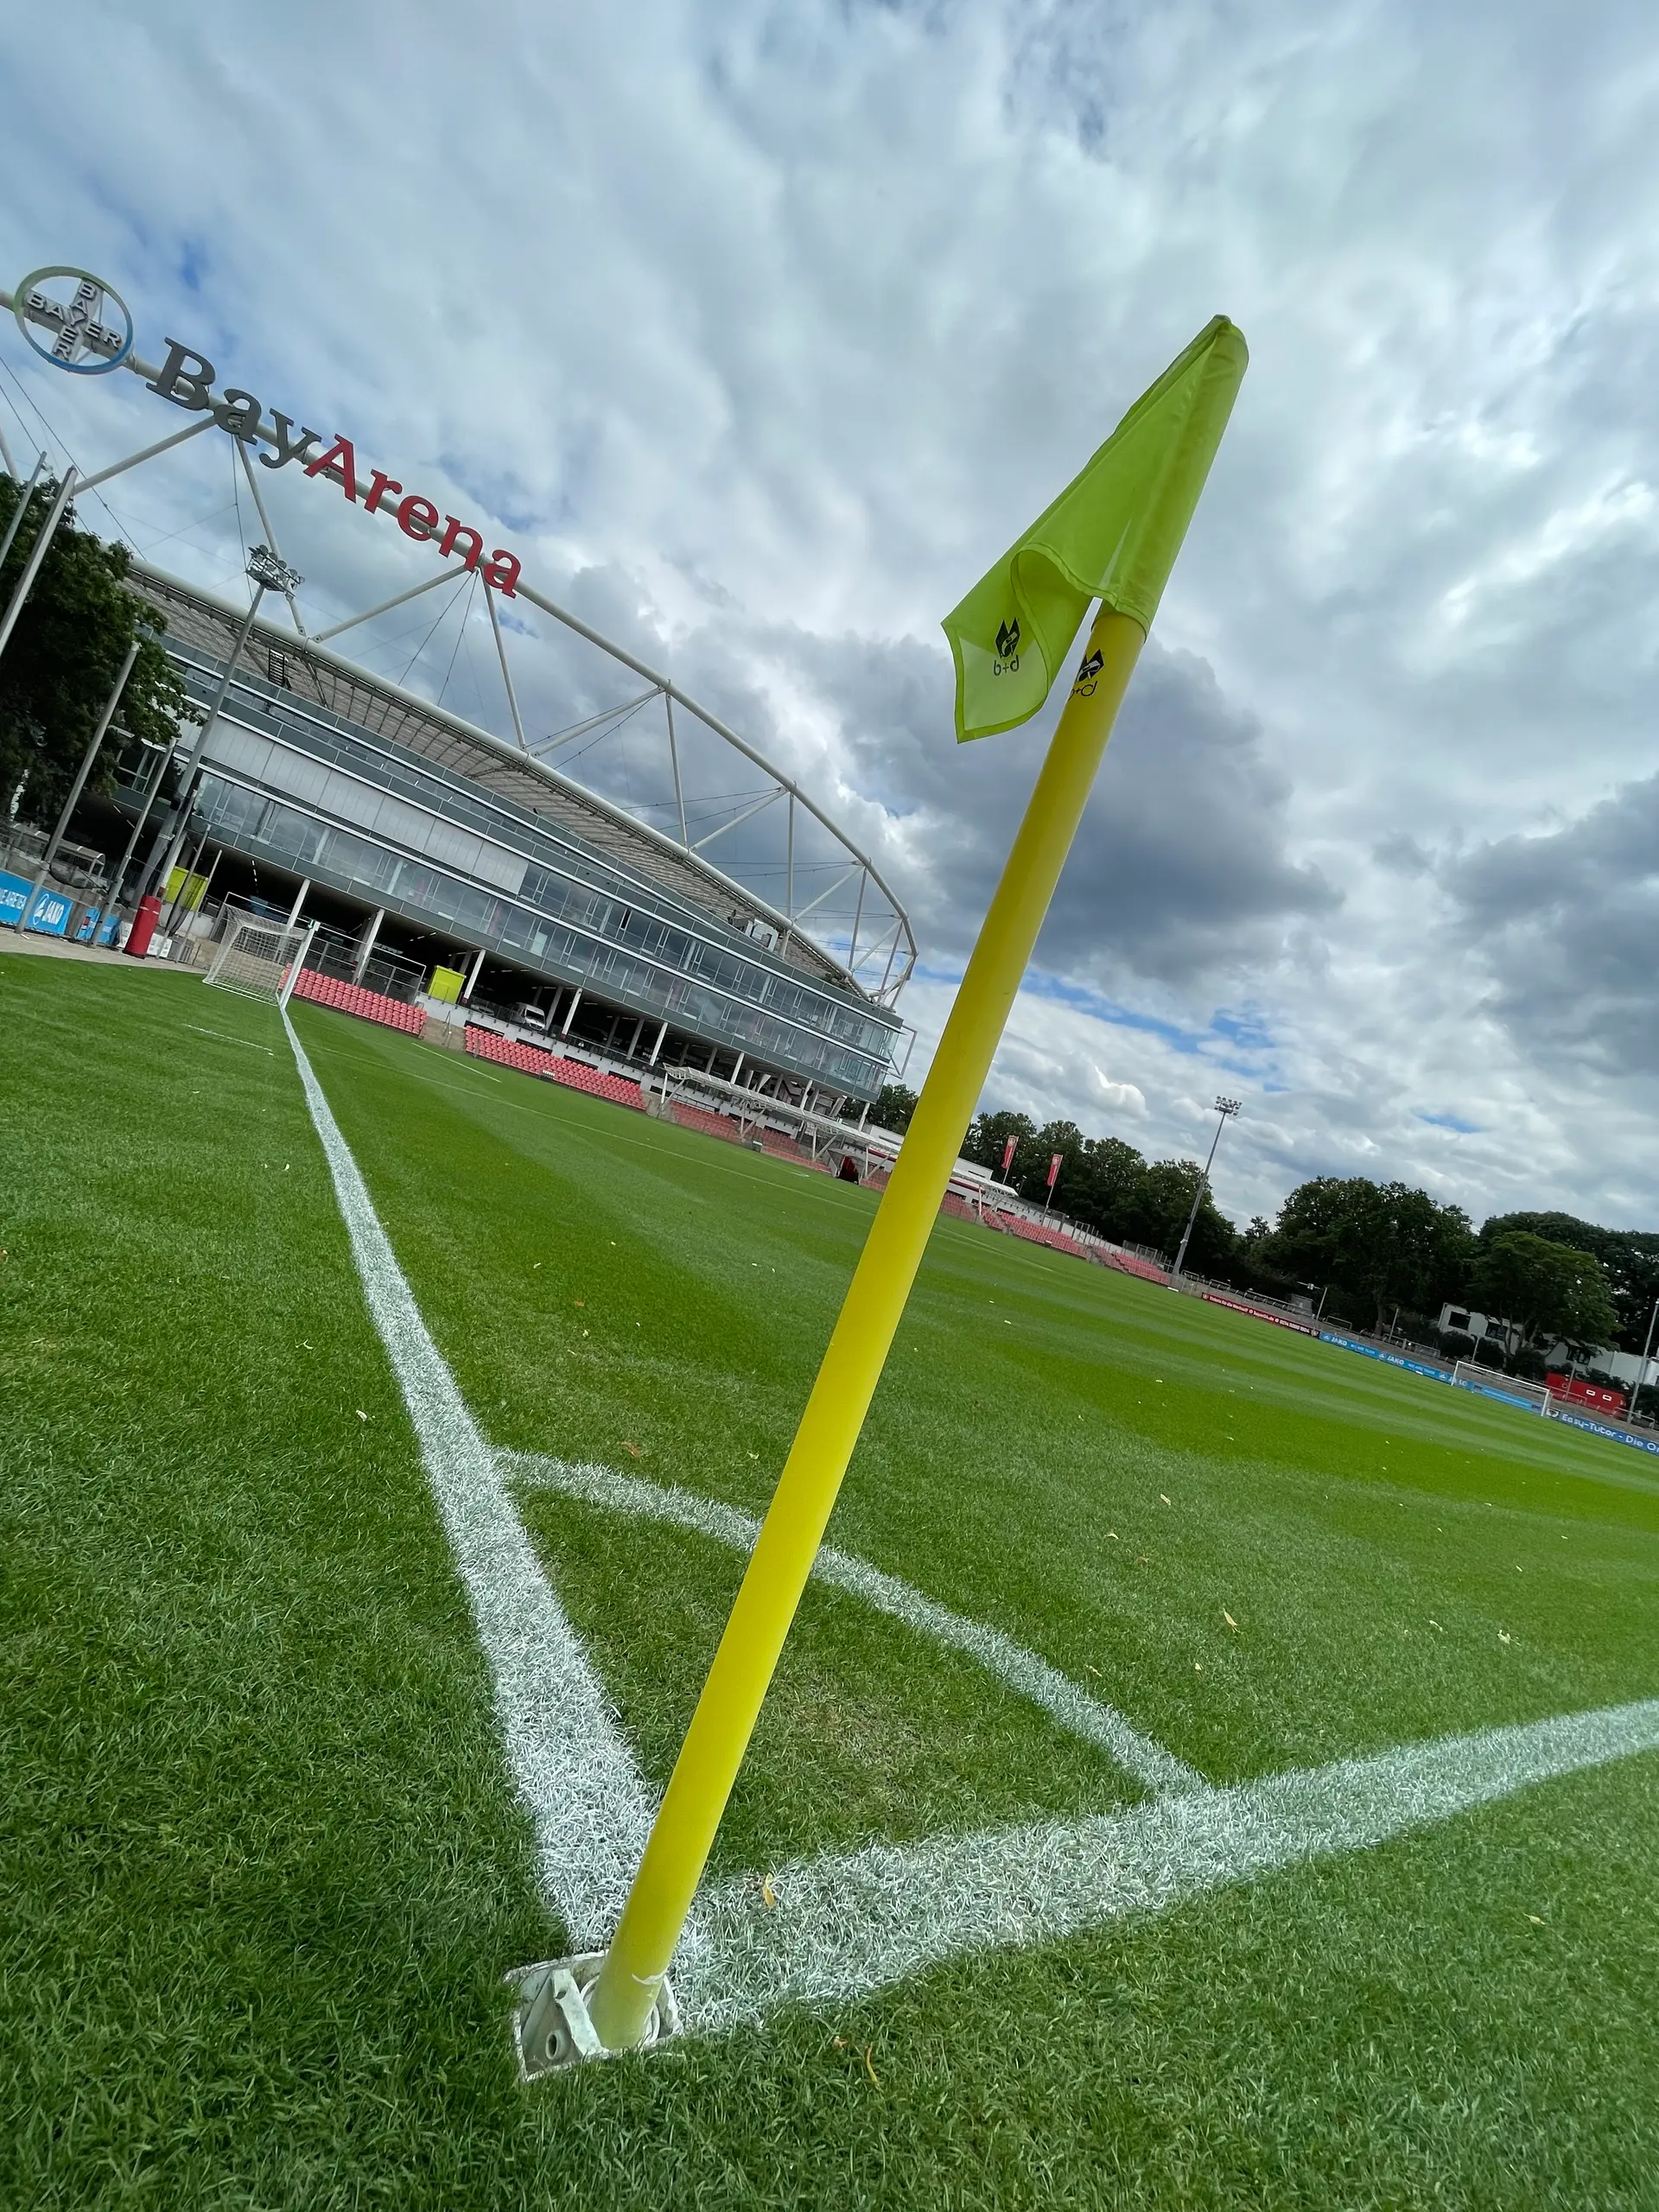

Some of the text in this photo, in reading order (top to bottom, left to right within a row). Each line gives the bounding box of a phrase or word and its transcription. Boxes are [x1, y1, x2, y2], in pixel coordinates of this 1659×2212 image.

[27, 294, 123, 349] BAYER
[53, 283, 97, 362] BAYER
[145, 336, 522, 599] BayArena
[993, 654, 1020, 677] b+d
[41, 900, 65, 925] JAKO
[1331, 1337, 1348, 1346] JAKO
[1387, 1355, 1405, 1366] JAKO
[1561, 1414, 1618, 1438] Easy-Tutor
[1625, 1435, 1644, 1447] Die
